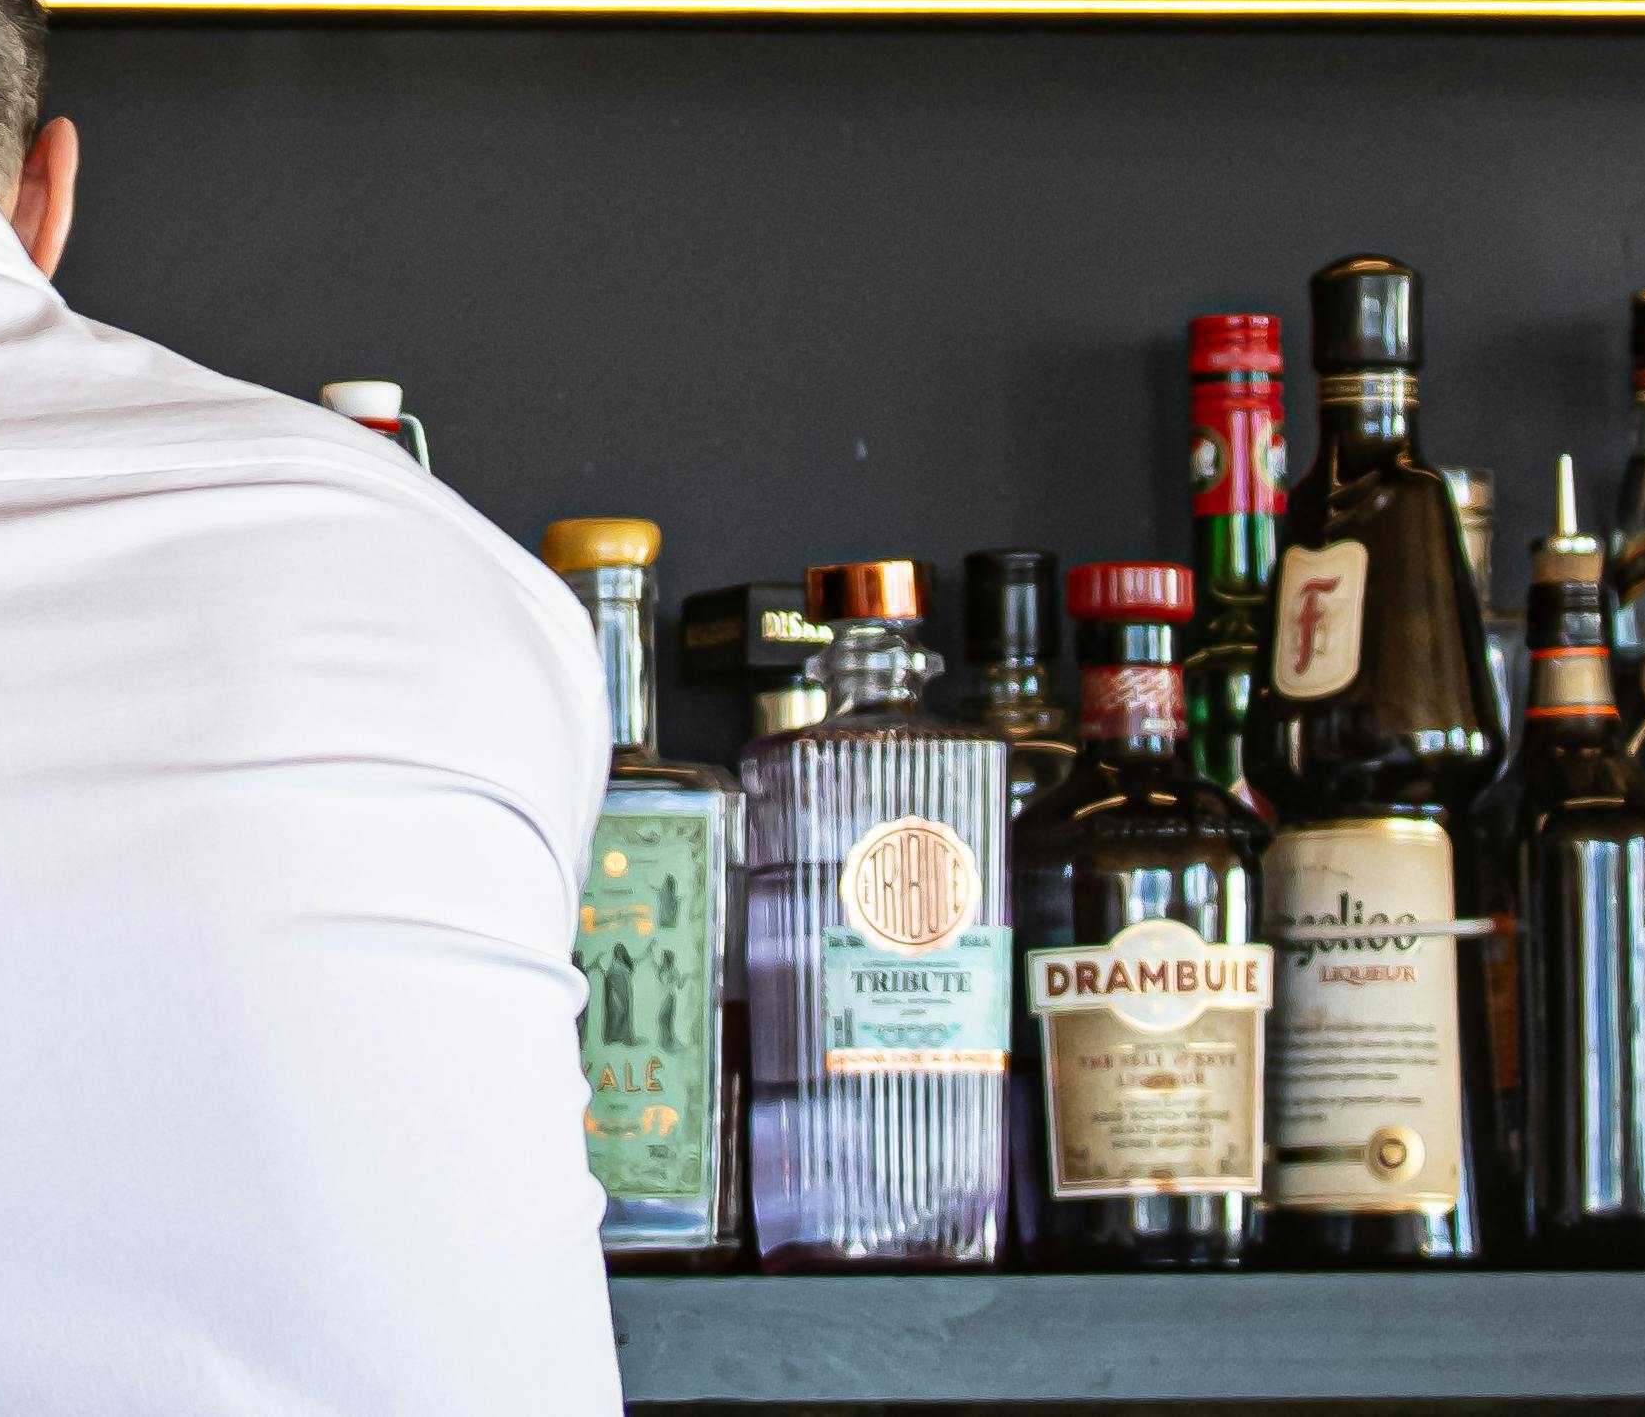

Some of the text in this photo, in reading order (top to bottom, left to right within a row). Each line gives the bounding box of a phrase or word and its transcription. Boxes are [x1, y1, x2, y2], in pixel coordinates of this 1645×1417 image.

[1295, 576, 1341, 675] F
[851, 969, 972, 993] TRIBUTE
[1046, 958, 1261, 998] DRAMBUIE
